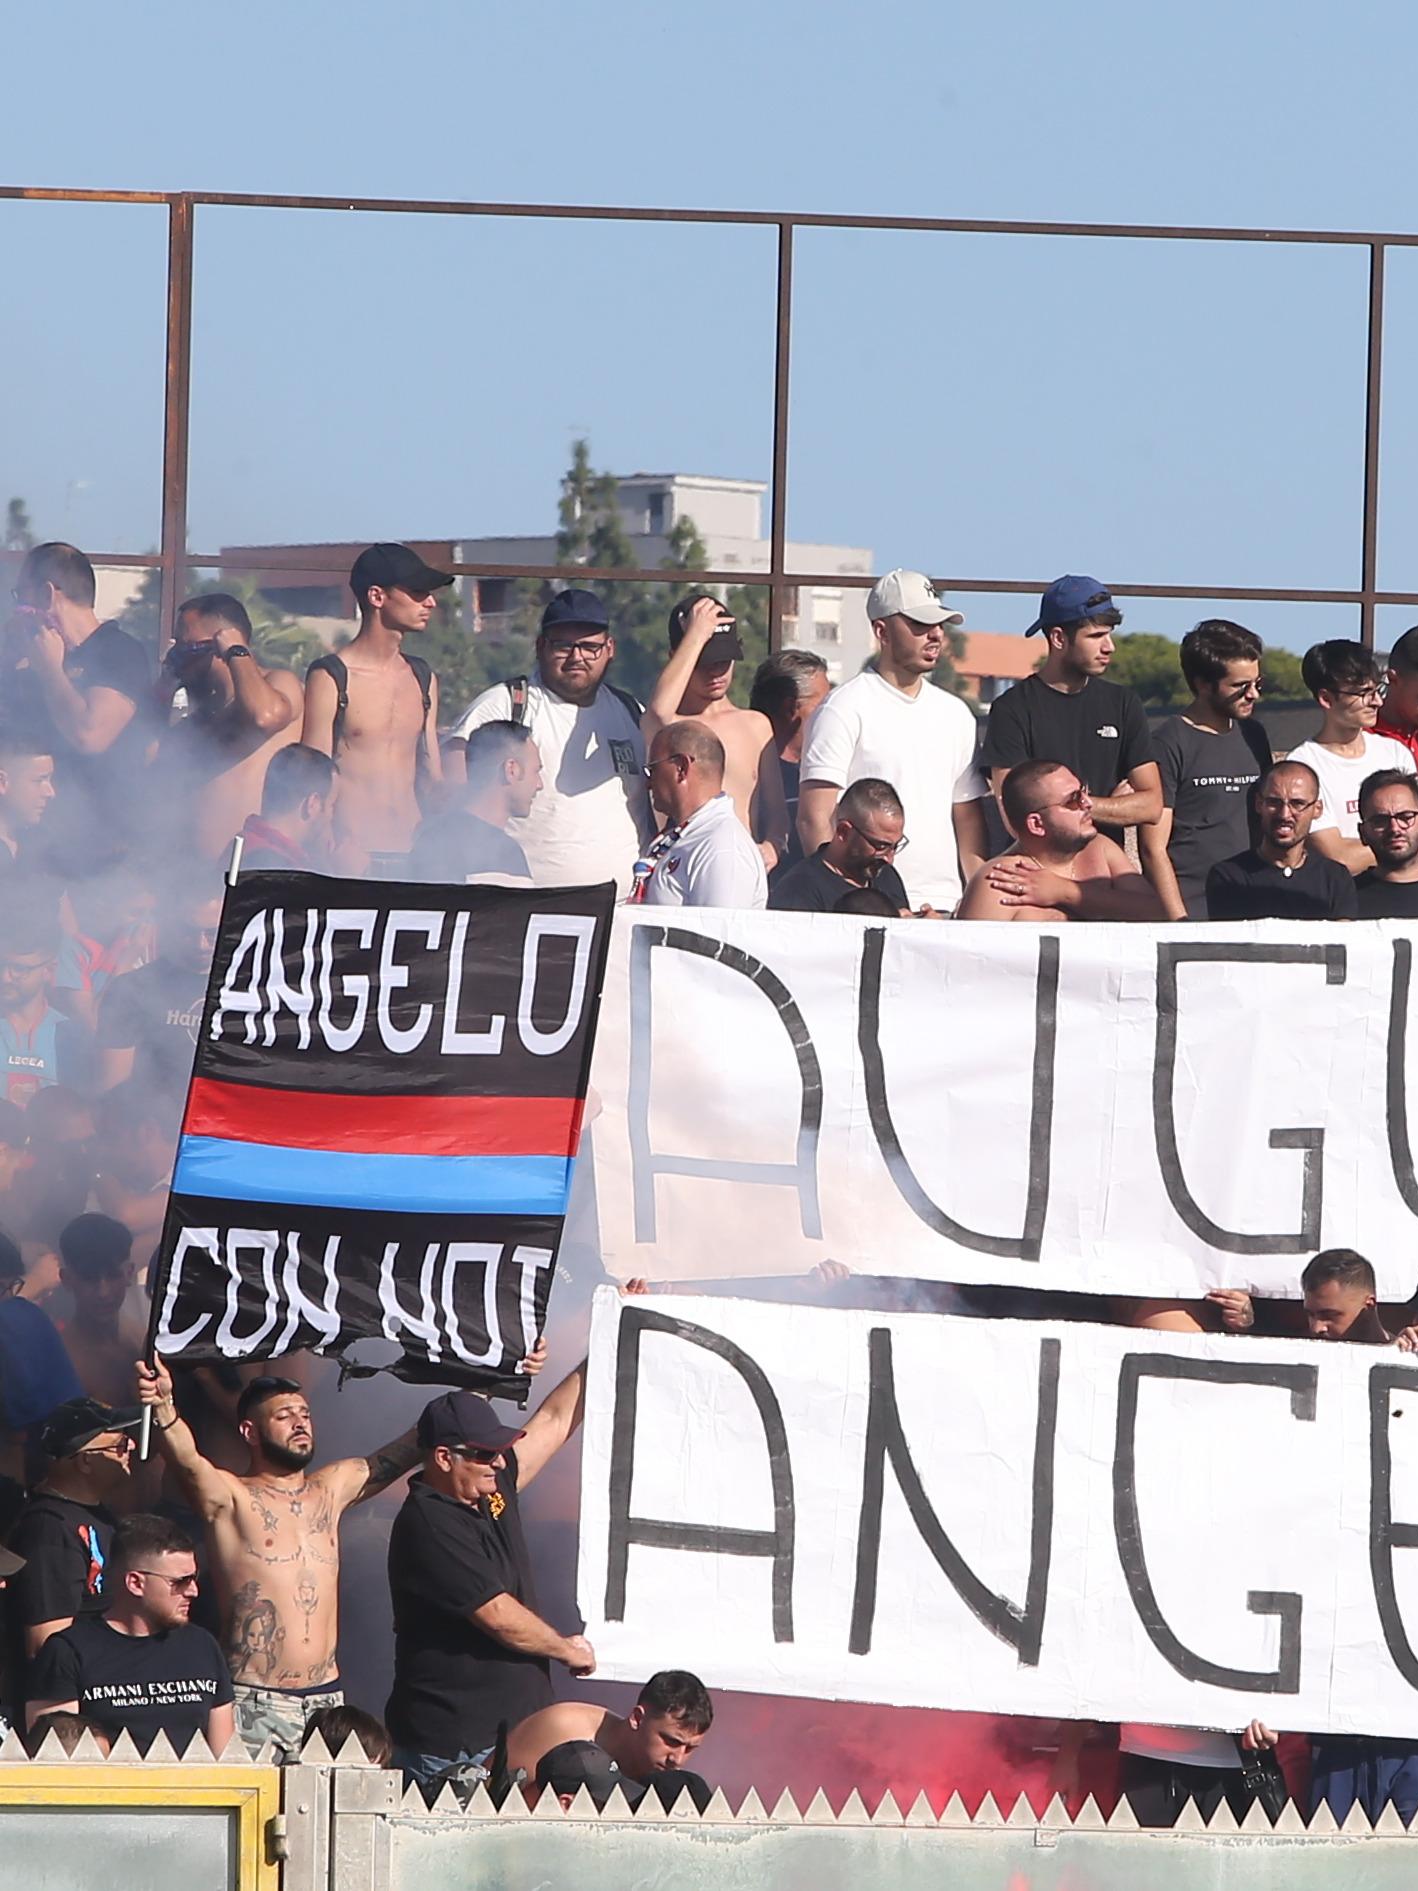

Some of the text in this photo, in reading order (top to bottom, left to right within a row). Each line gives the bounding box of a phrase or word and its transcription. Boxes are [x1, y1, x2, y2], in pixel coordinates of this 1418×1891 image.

[1193, 776, 1227, 786] TOMMY
[209, 908, 597, 1056] ANGELO
[166, 1008, 202, 1027] Har
[154, 1227, 341, 1359] CON
[83, 1684, 143, 1701] ARMANI
[111, 1697, 149, 1707] MILANO
[156, 1695, 176, 1704] NEW
[177, 1694, 202, 1703] YORK
